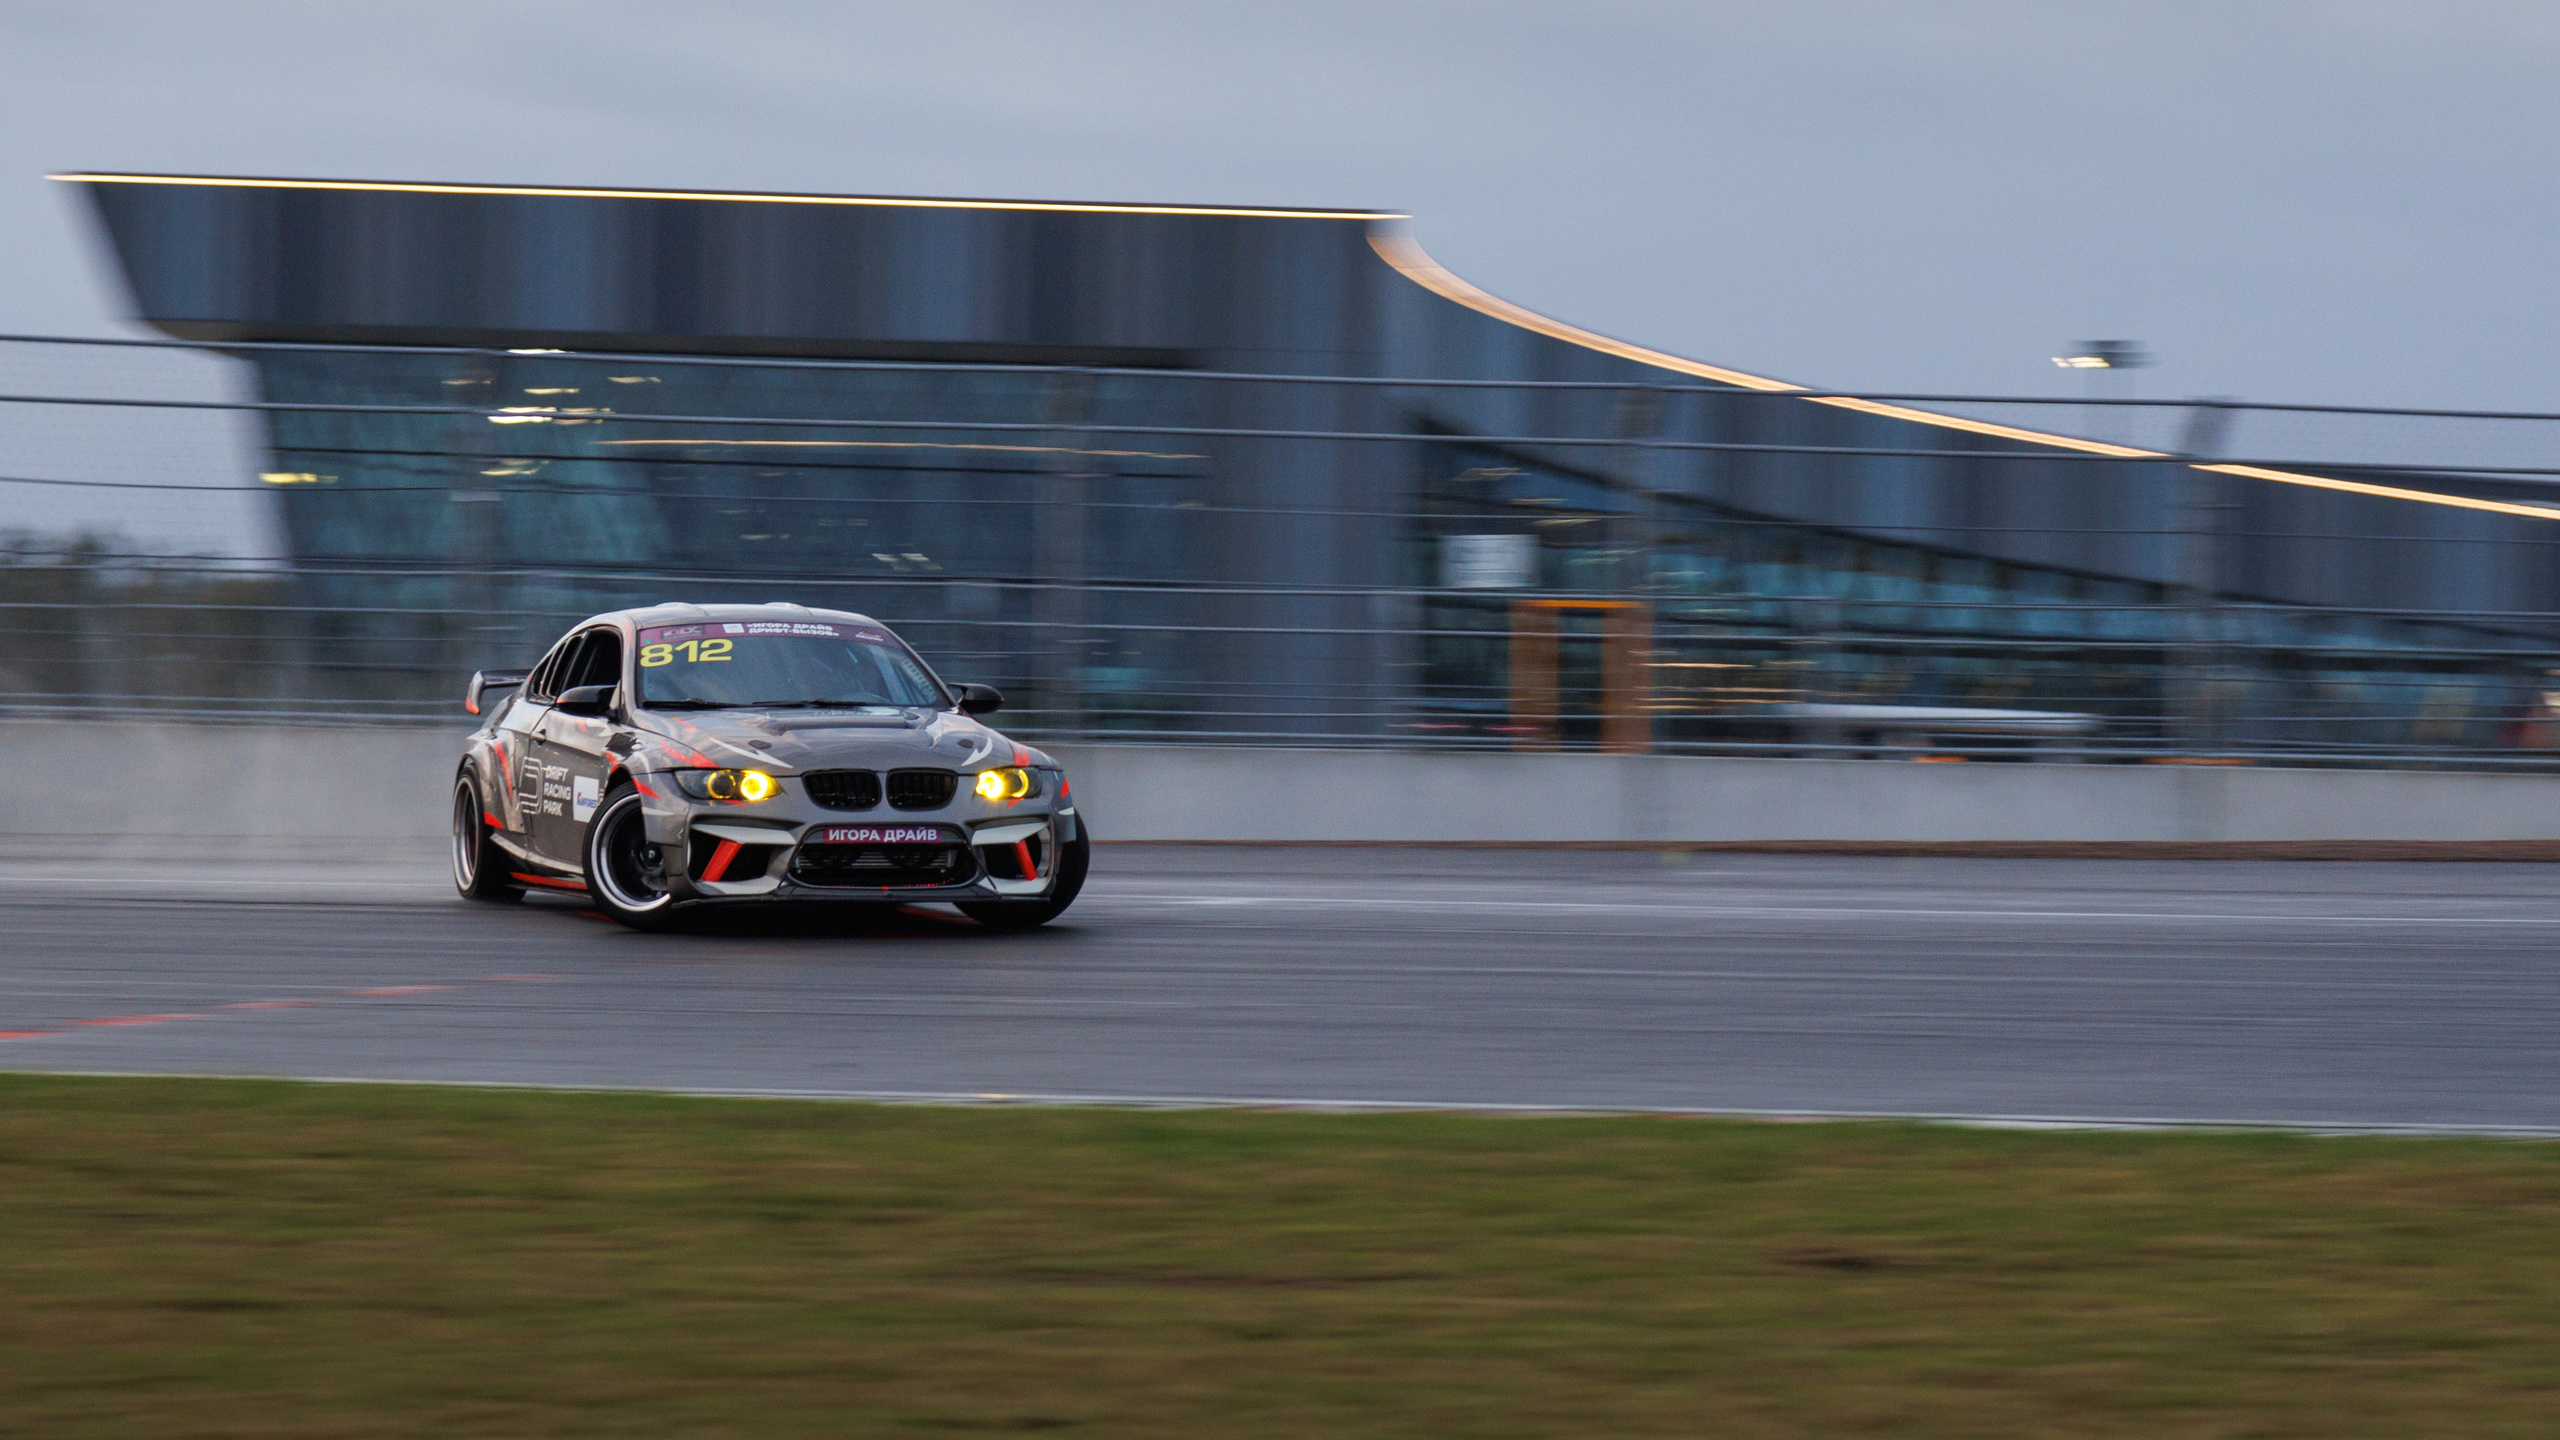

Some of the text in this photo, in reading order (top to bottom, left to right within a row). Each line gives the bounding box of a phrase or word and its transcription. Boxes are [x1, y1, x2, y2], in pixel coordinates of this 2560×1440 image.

[793, 623, 834, 632] ДРАЙВ
[640, 638, 733, 668] 812
[545, 764, 569, 782] DRIFT
[543, 782, 572, 801] RACING
[543, 799, 563, 817] PARK
[828, 827, 938, 843] ИГОРА ДРАЙВ
